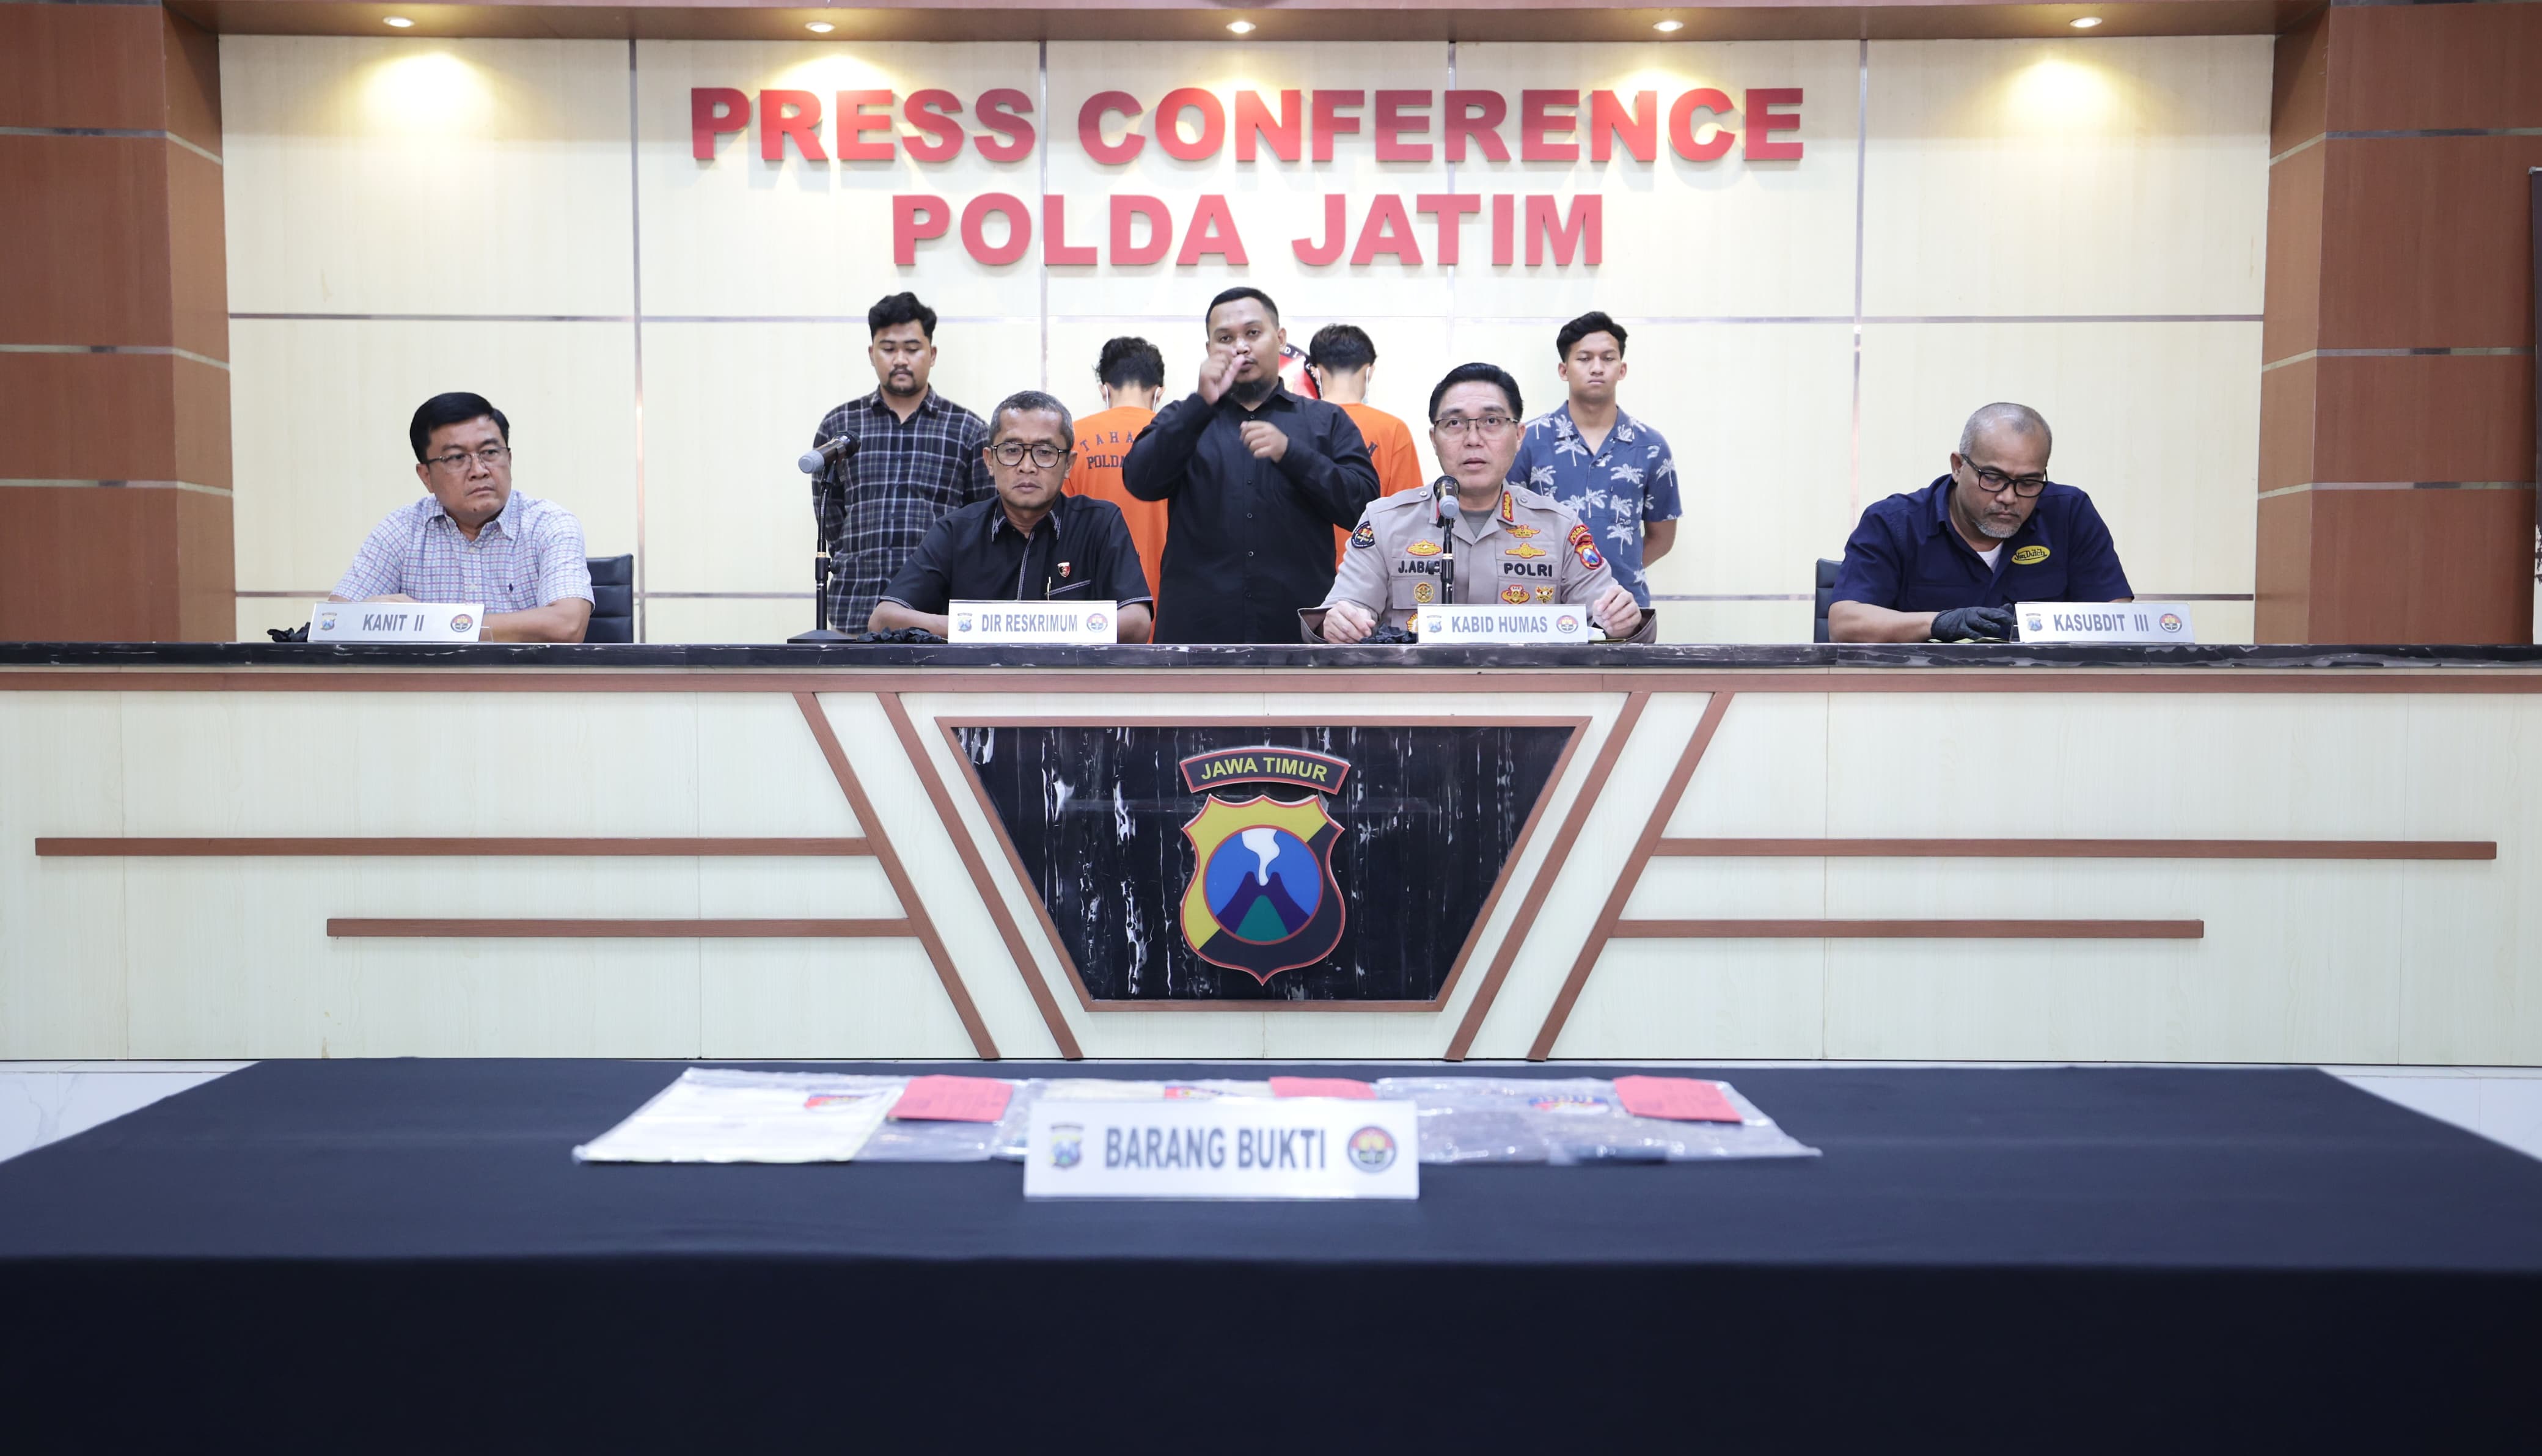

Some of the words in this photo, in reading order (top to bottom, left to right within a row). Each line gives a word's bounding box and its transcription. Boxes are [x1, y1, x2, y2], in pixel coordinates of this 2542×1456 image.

[692, 87, 1035, 163] PRESS
[1078, 87, 1803, 163] CONFERENCE
[893, 193, 1248, 266] POLDA
[1292, 194, 1602, 266] JATIM
[1080, 431, 1134, 452] TAHA
[1504, 563, 1553, 577] POLRI
[362, 613, 408, 631] KANIT
[414, 614, 425, 631] II
[981, 614, 1002, 632] DIR
[1005, 614, 1077, 632] RESKRIMUM
[1451, 616, 1494, 633] KABID
[1498, 616, 1548, 633] HUMAS
[2053, 613, 2125, 632] KASUBDIT
[2134, 614, 2149, 632] III
[1201, 758, 1258, 780] JAWA
[1263, 757, 1327, 781] TIMUR
[1105, 1127, 1226, 1169] BARANG
[1237, 1128, 1325, 1170] BUKTI
